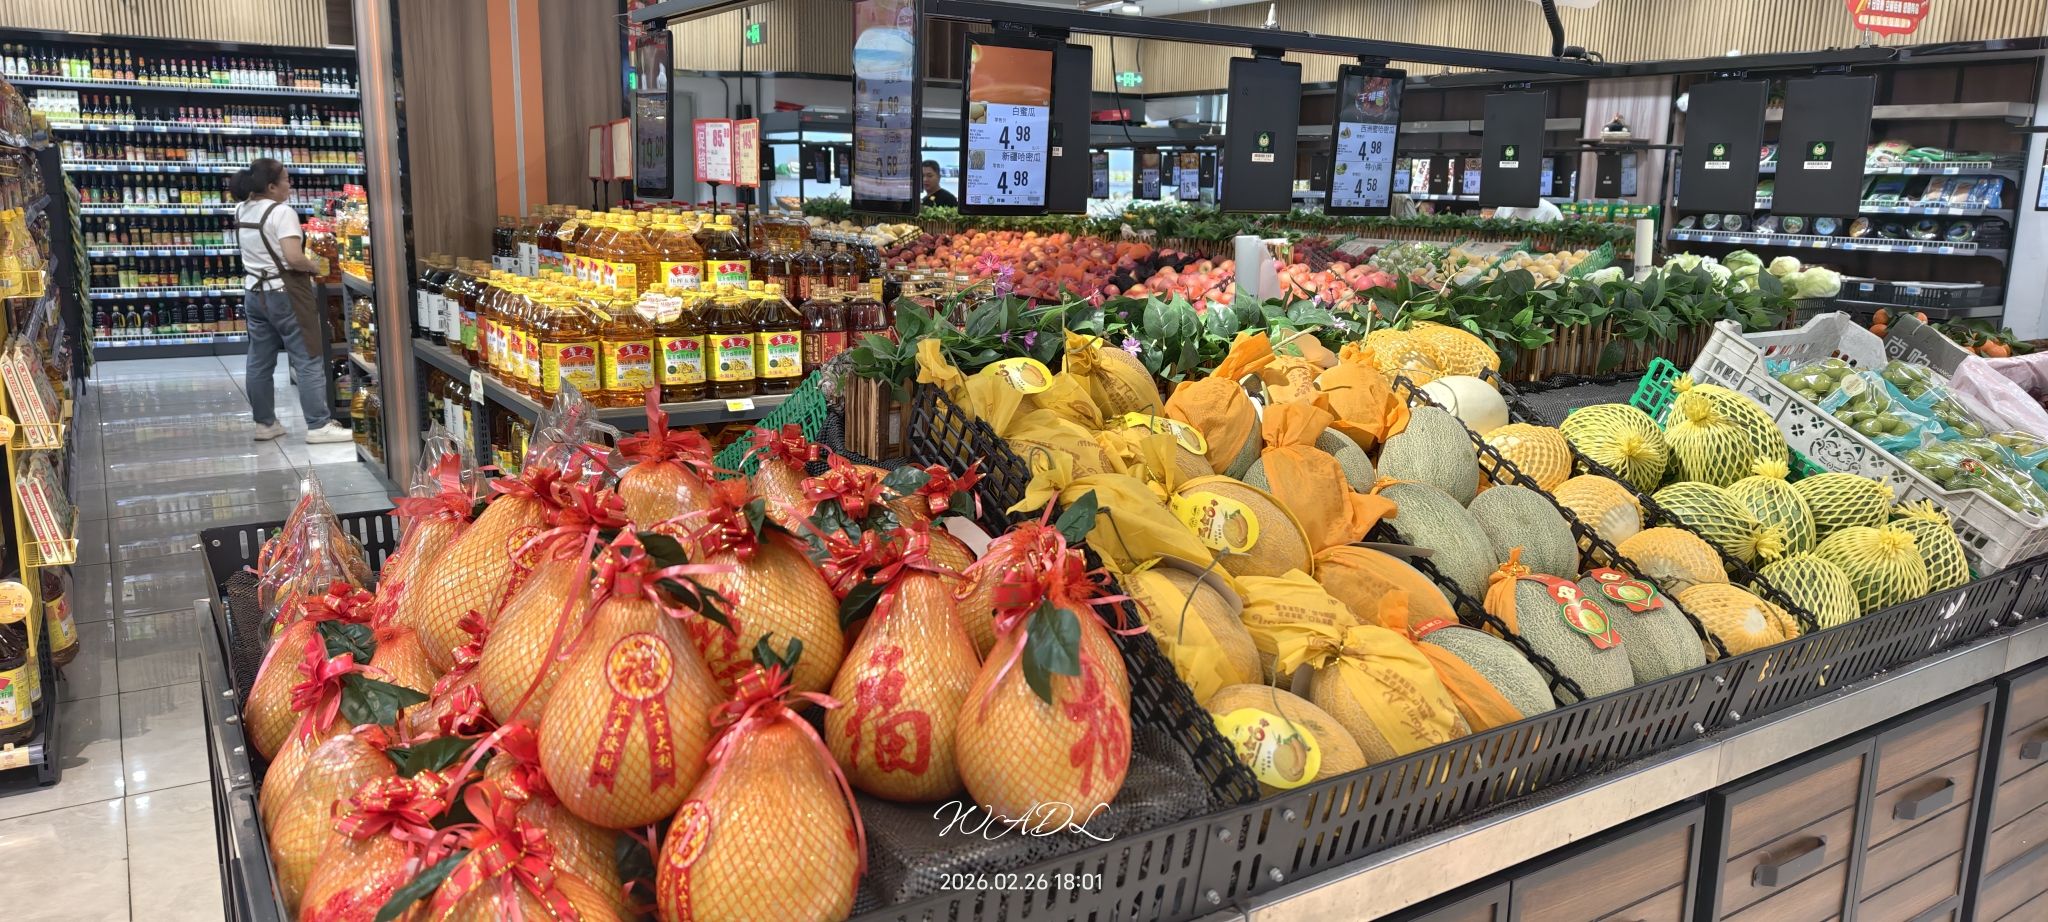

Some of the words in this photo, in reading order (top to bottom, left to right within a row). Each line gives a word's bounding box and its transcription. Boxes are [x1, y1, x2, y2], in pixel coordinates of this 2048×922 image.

[1012, 107, 1036, 117] 白蜜瓜
[999, 126, 1030, 150] 4.98
[1002, 152, 1040, 162] 新疆哈密瓜
[1358, 140, 1382, 160] 4.98
[997, 170, 1028, 194] 4.98
[1354, 178, 1378, 198] 4.58
[846, 645, 931, 776] 福
